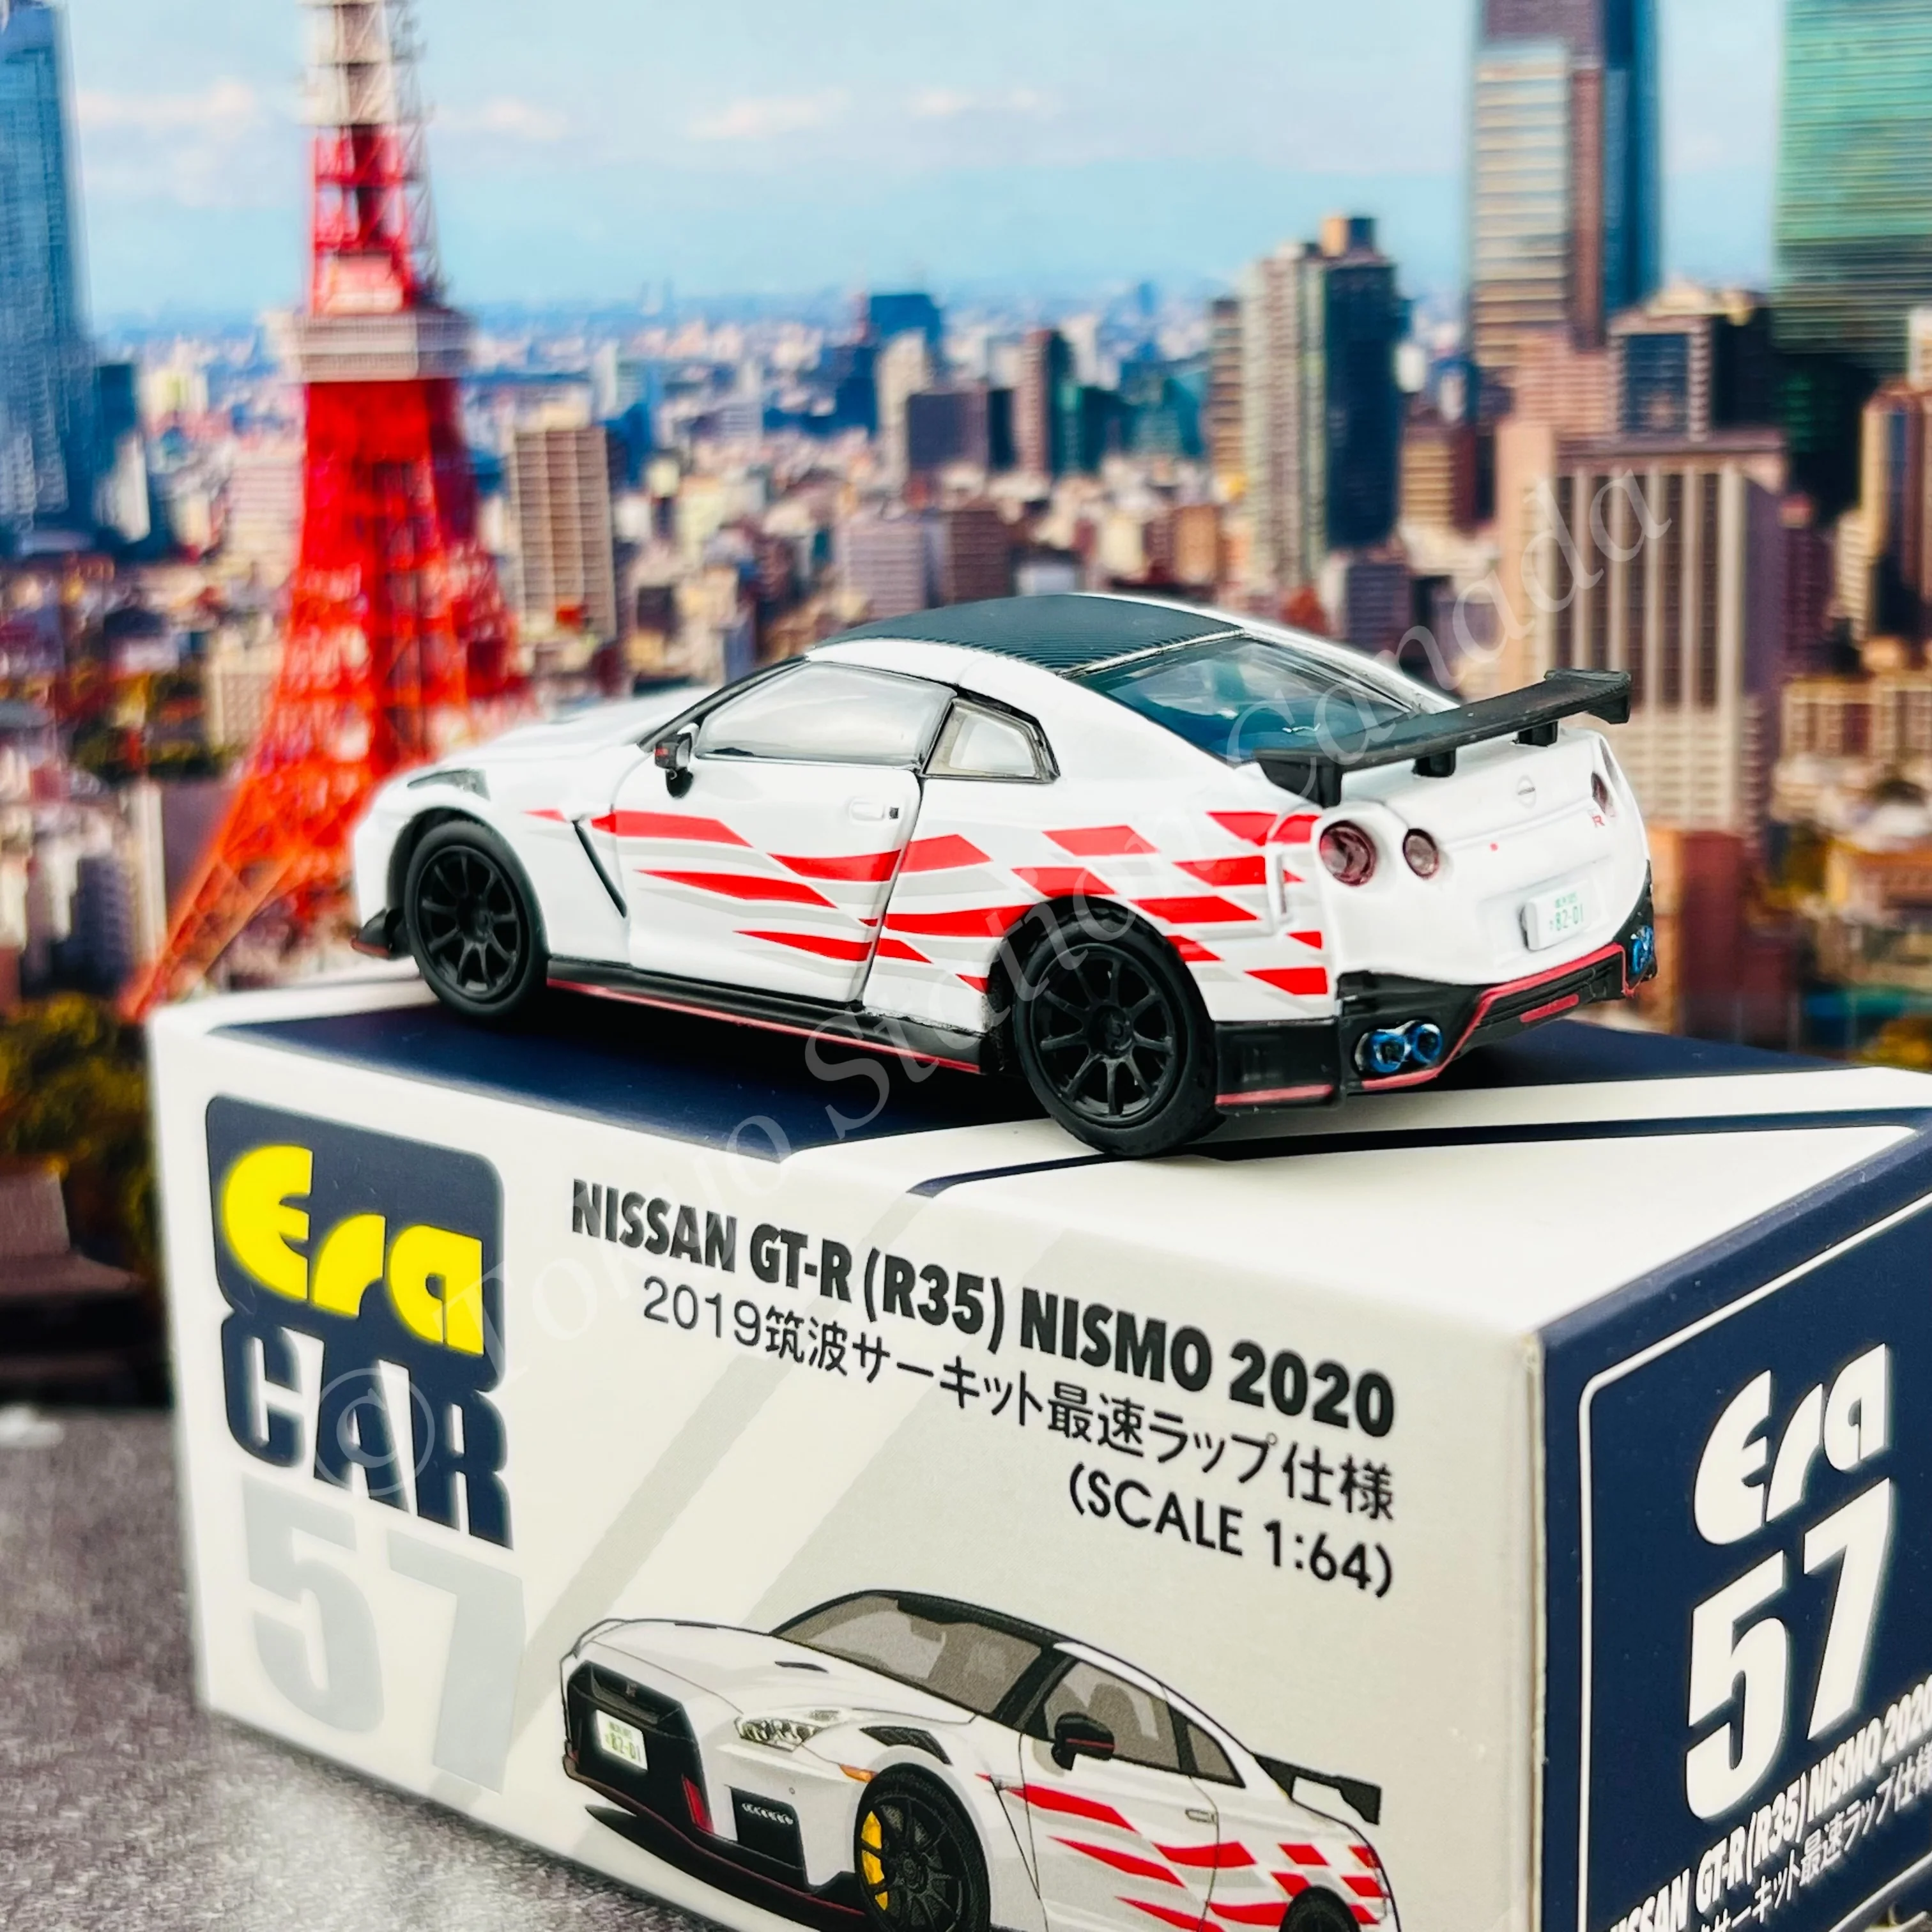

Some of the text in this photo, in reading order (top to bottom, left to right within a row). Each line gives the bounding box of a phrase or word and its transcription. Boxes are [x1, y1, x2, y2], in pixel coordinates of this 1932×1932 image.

[222, 1144, 484, 1356] Era
[572, 1178, 1395, 1438] NISSAN GT-R (R35) NISMO 2020
[220, 1310, 514, 1551] CAR
[643, 1276, 1393, 1521] 2019筑波サーキット最速ラップ仕様
[1694, 1343, 1886, 1545] Era
[241, 1469, 526, 1794] 57
[1070, 1462, 1393, 1598] (SCALE 1:64)
[1686, 1477, 1891, 1820] 57
[1696, 1825, 1746, 1913] GT-R
[1746, 1770, 1807, 1885] (R35)
[1807, 1717, 1882, 1823] NISMO
[1880, 1673, 1932, 1764] 2020
